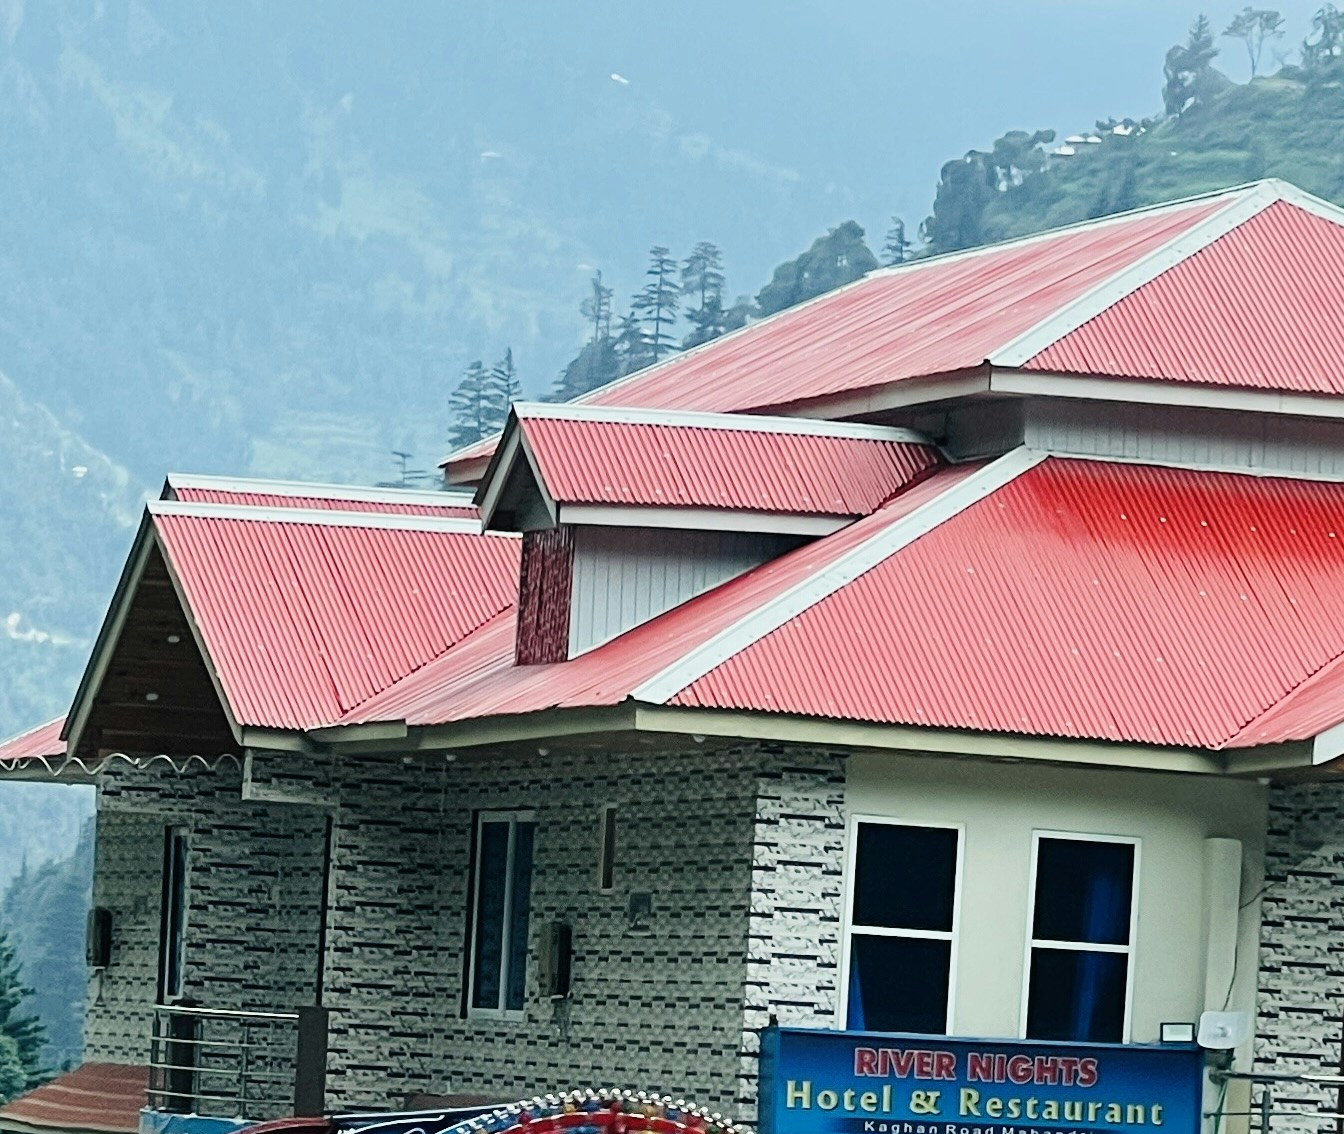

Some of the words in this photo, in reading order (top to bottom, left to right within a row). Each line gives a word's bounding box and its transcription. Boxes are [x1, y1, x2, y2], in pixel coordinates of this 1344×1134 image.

[854, 1047, 957, 1081] RIVER
[966, 1052, 1099, 1088] NIGHTS
[786, 1079, 892, 1114] Hotel
[909, 1089, 942, 1115] &
[959, 1087, 1164, 1126] Restaurant
